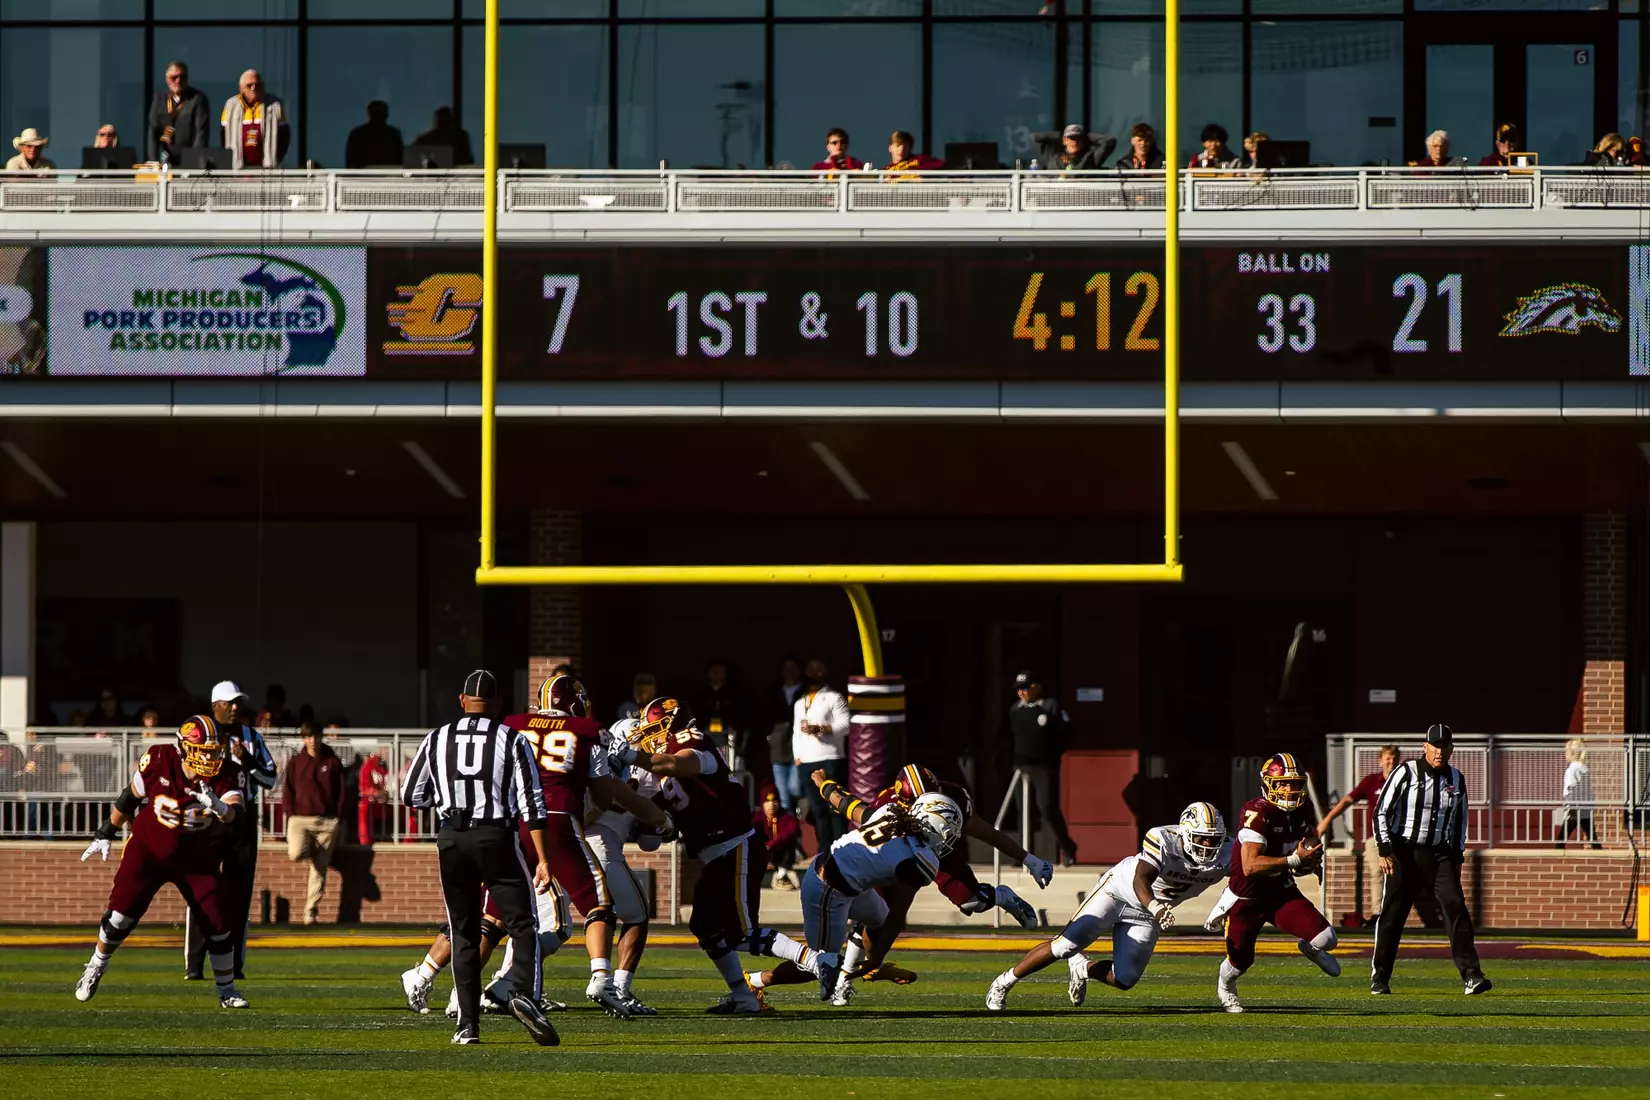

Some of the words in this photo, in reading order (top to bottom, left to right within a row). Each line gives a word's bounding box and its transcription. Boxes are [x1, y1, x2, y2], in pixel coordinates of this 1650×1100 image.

[1576, 51, 1587, 65] 6
[1238, 252, 1296, 273] BALL
[1299, 252, 1331, 273] ON
[132, 288, 264, 308] MICHIGAN
[83, 309, 156, 331] PORK
[162, 309, 319, 331] PRODUCERS
[542, 273, 580, 355] 7
[1012, 271, 1161, 352] 4:12
[1391, 272, 1464, 353] 21
[667, 290, 769, 358] 1ST
[798, 290, 830, 341] &
[856, 290, 919, 358] 10
[1256, 292, 1317, 354] 33
[109, 331, 283, 351] ASSOCIATION
[527, 717, 566, 730] BOOTH
[454, 734, 488, 776] U
[1243, 809, 1259, 829] 7
[1160, 881, 1193, 899] 2
